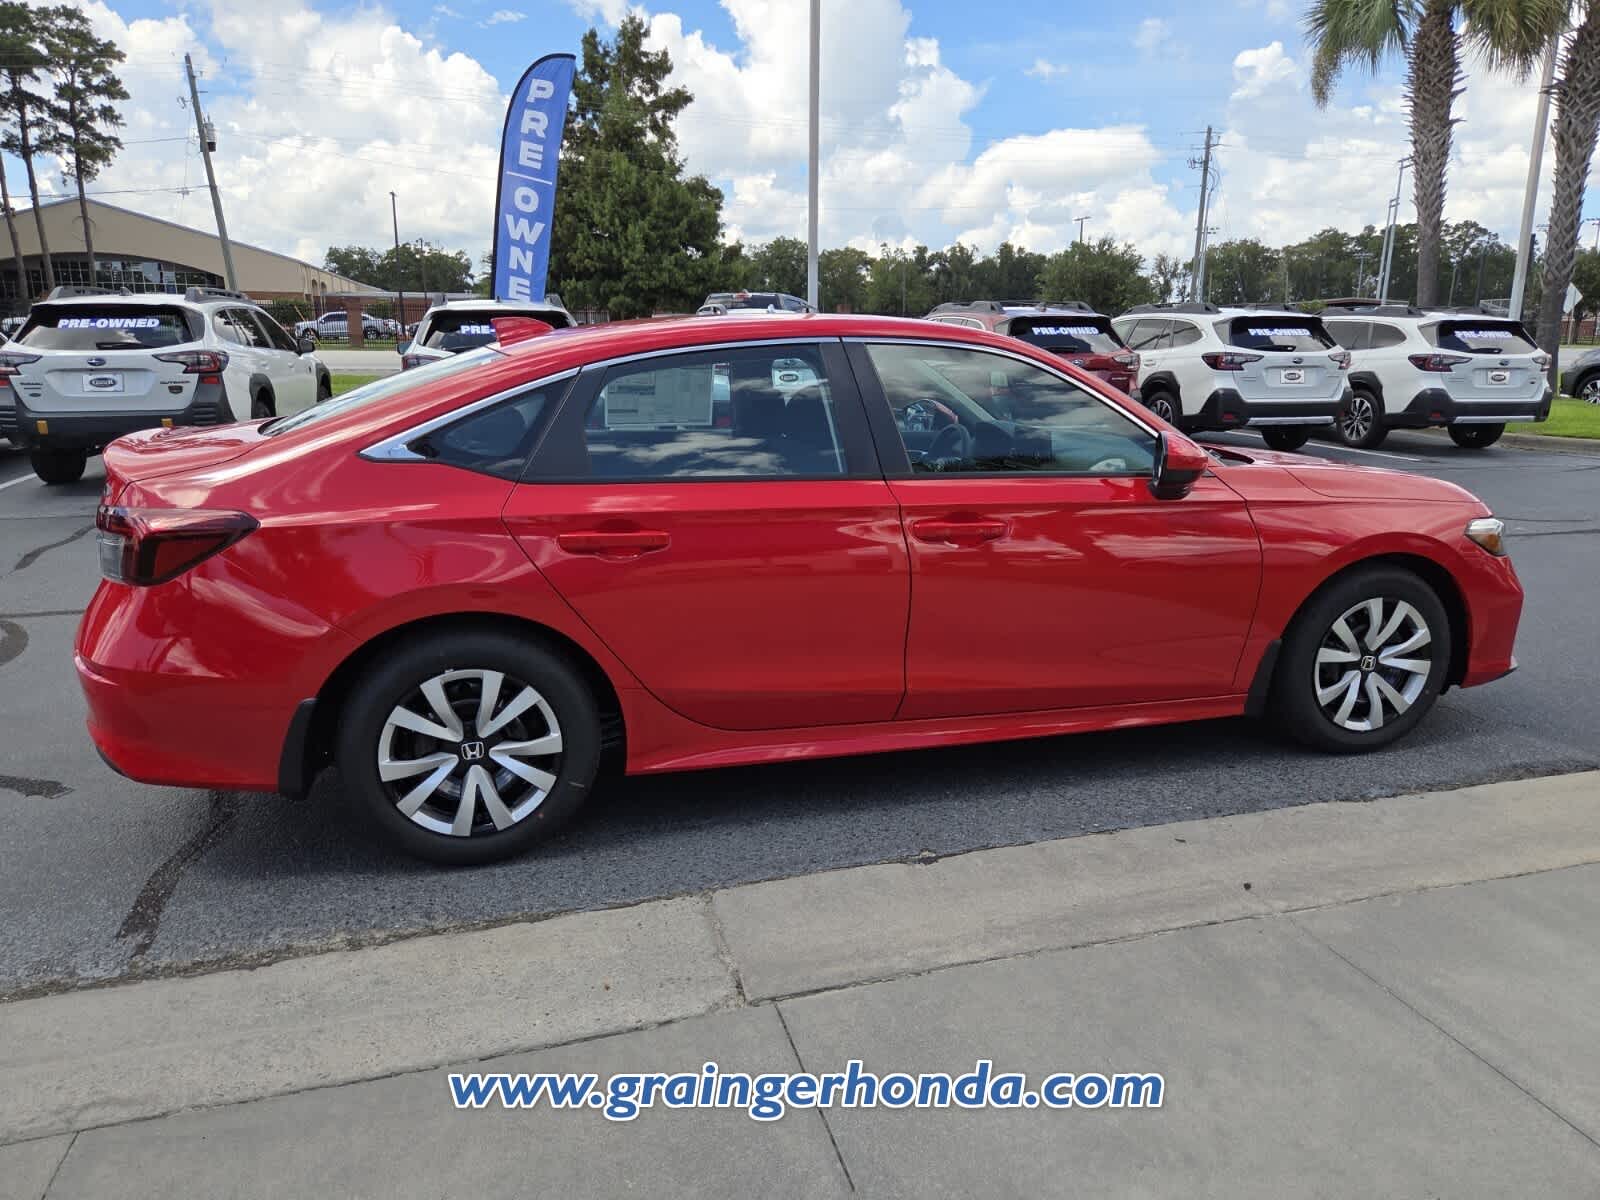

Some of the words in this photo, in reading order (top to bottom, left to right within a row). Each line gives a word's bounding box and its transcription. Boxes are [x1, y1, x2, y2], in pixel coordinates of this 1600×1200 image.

[506, 186, 545, 302] OWNE
[58, 318, 160, 329] PRE-OWNED
[461, 325, 496, 334] PRE-
[1032, 327, 1099, 335] PRE-OWNED
